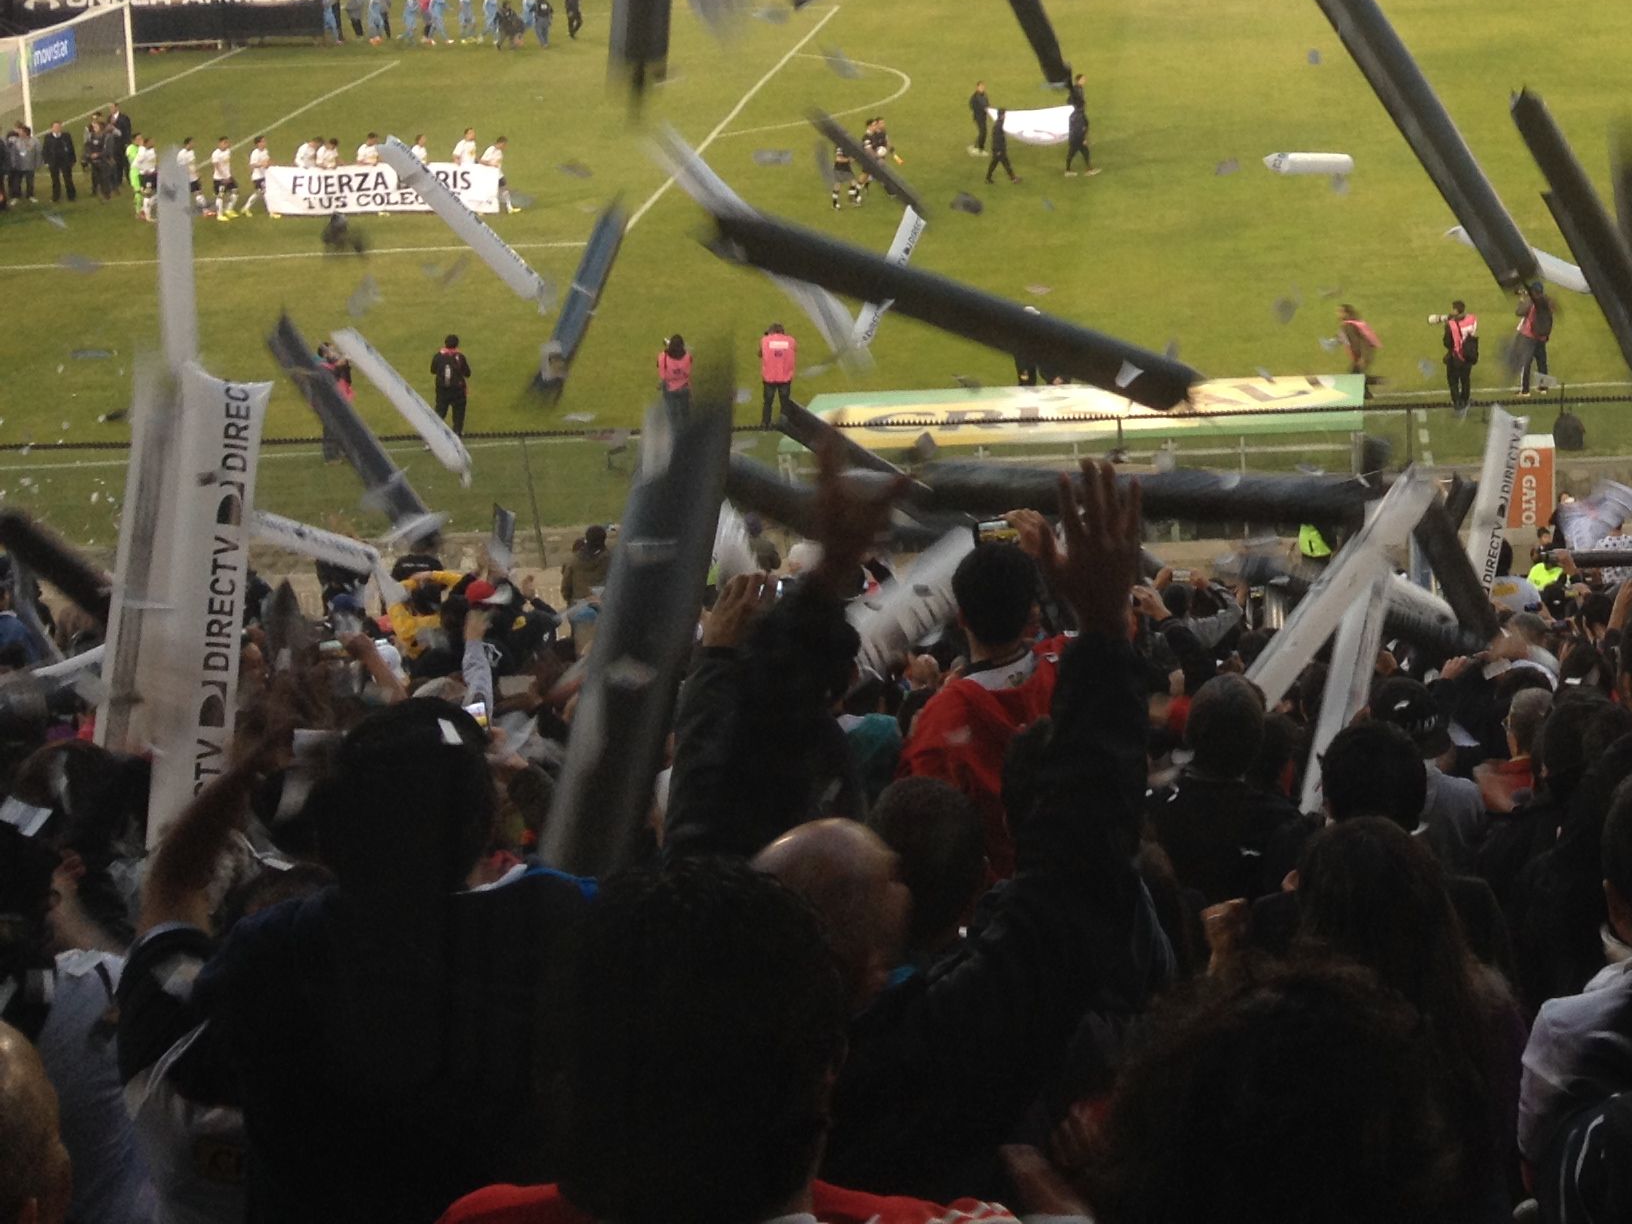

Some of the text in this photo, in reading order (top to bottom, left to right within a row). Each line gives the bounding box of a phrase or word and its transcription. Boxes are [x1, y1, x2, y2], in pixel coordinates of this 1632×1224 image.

[33, 39, 69, 68] movistar
[292, 171, 389, 196] FUERZA
[222, 385, 251, 473] DIREC
[1501, 436, 1521, 495] DIRECTV
[1521, 475, 1537, 524] GATO
[1485, 524, 1503, 584] DIRECTV
[203, 535, 240, 672] DIRECTV
